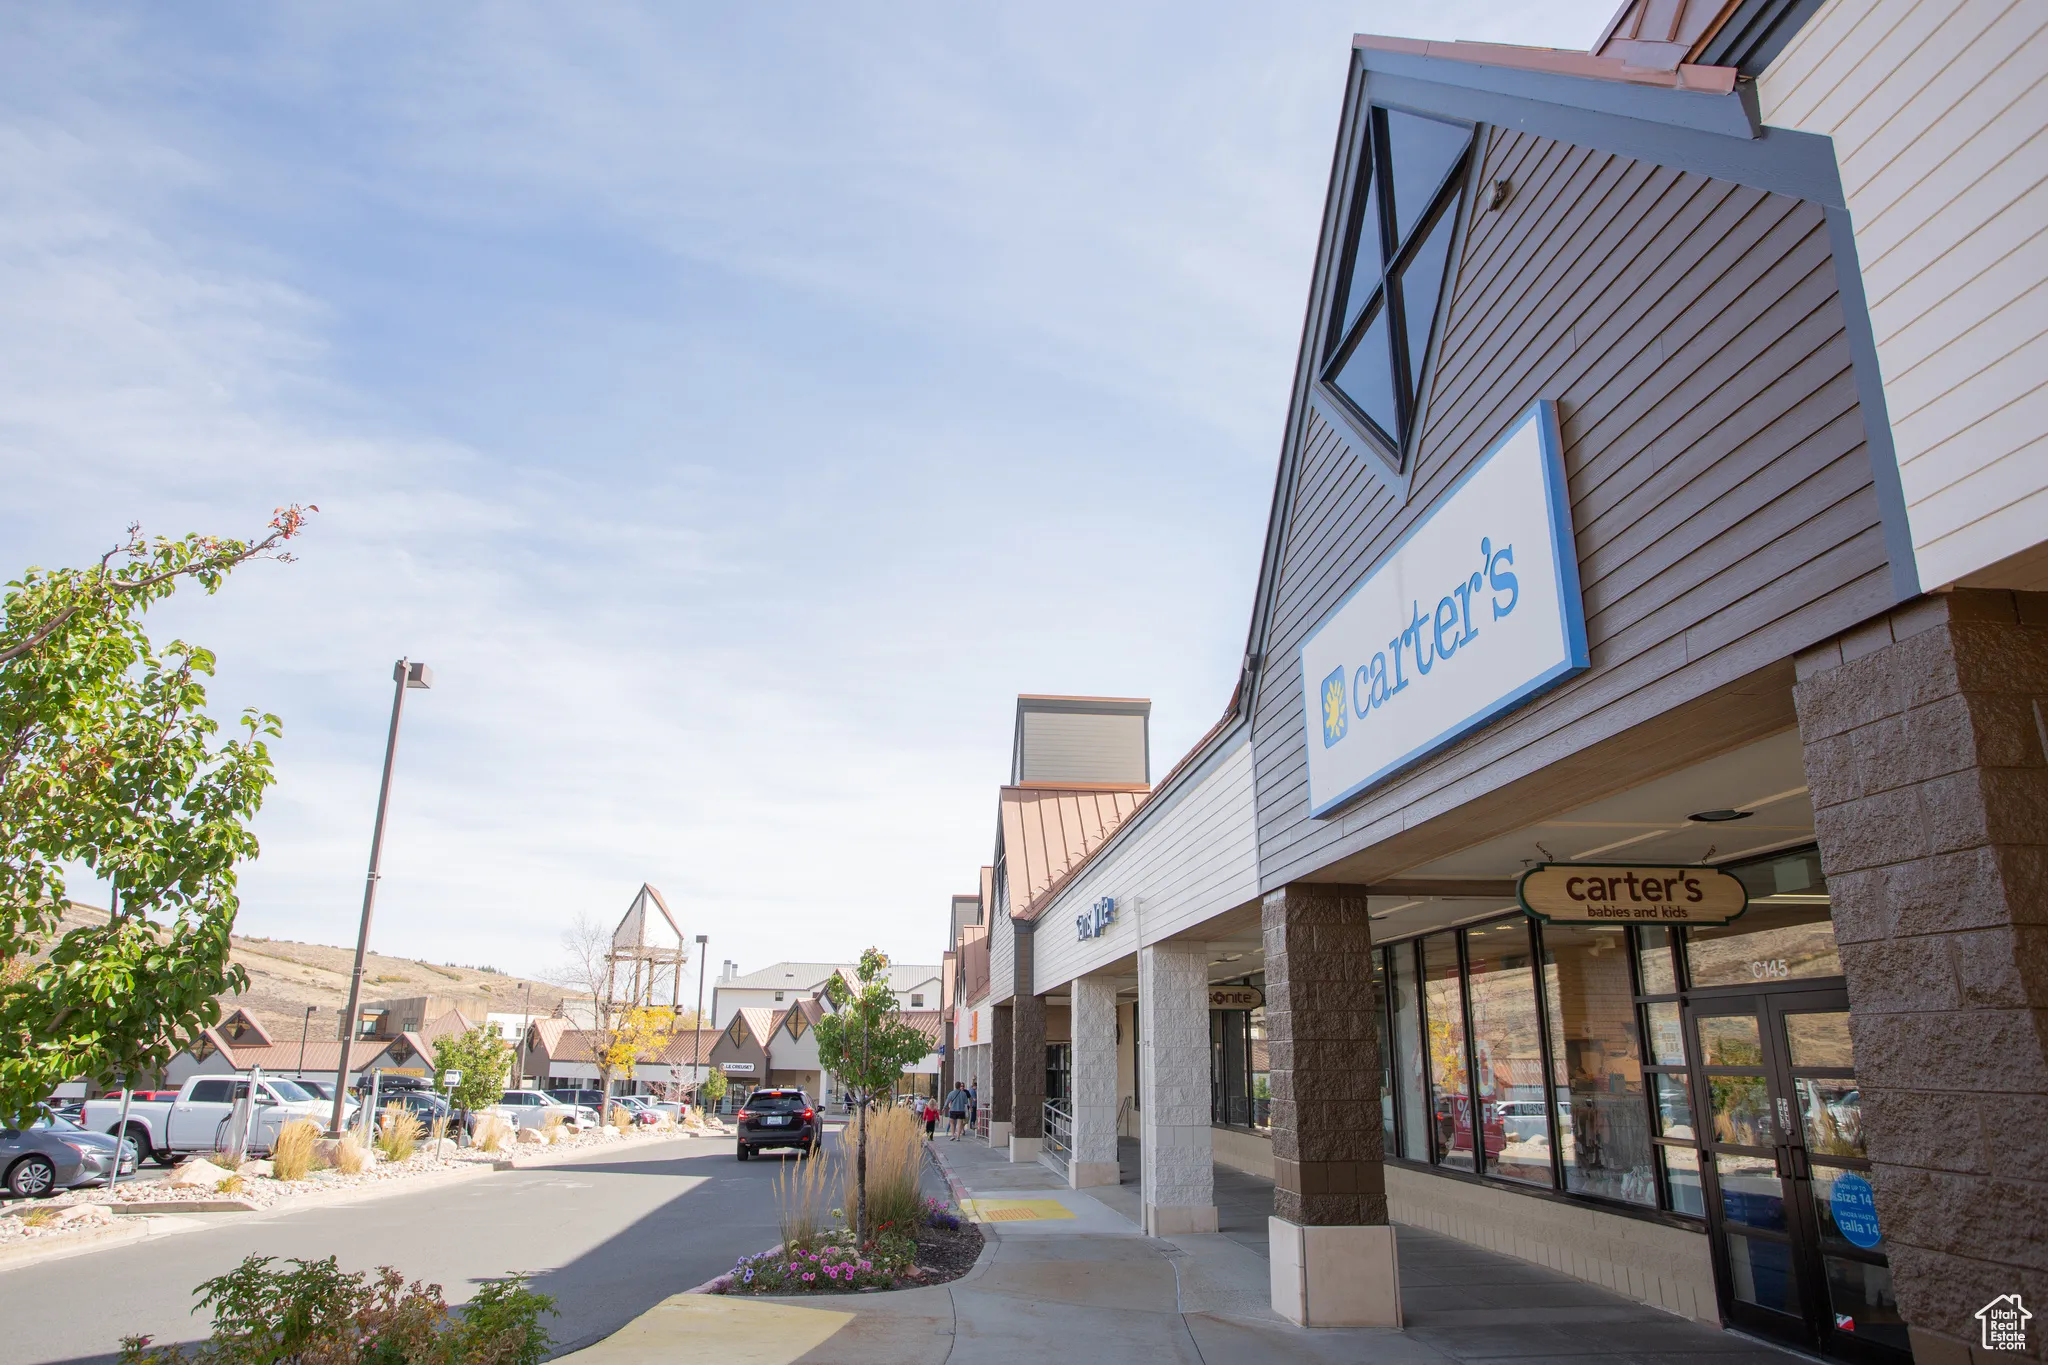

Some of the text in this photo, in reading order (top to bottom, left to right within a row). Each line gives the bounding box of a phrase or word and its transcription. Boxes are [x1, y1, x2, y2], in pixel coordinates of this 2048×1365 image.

[1352, 536, 1519, 720] carter's
[1566, 870, 1703, 902] carter's
[1587, 905, 1688, 919] babies and kids
[1752, 959, 1788, 978] C145
[1836, 1190, 1872, 1206] size 14
[1840, 1211, 1875, 1221] AHORA HASTA
[1840, 1220, 1879, 1236] talla 14
